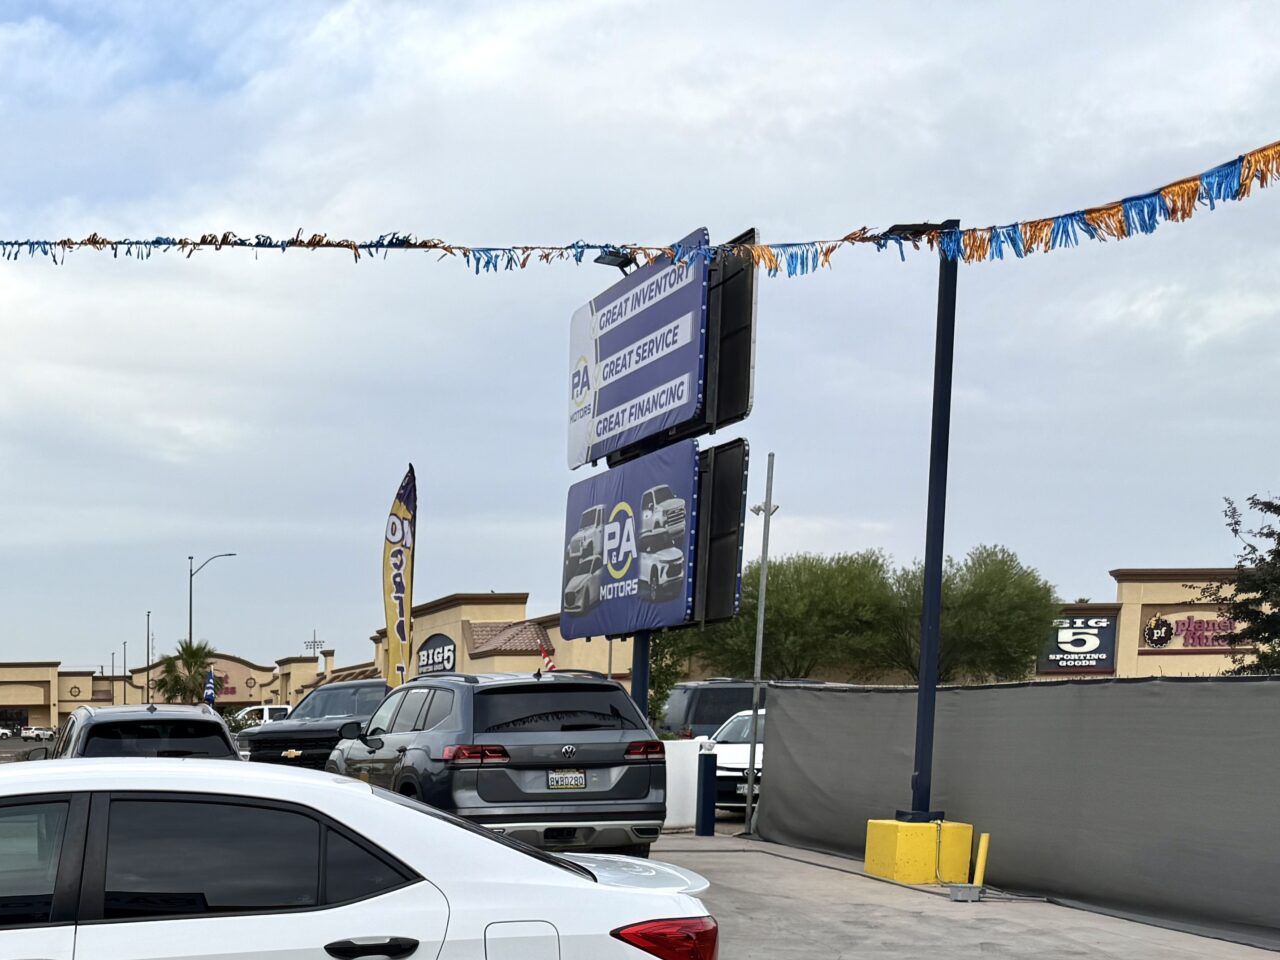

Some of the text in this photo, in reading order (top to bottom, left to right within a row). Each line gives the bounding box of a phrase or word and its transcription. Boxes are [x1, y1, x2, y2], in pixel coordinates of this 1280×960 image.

[599, 256, 694, 331] GREAT INVENTORY
[602, 325, 679, 381] GREAT SERVICE
[596, 381, 685, 438] GREAT FINANCING
[603, 518, 637, 565] P&A
[600, 579, 638, 601] MOTORS
[1052, 618, 1110, 628] BIG
[1153, 627, 1166, 640] pf
[1057, 628, 1101, 653] 5
[419, 644, 455, 670] BIG 5
